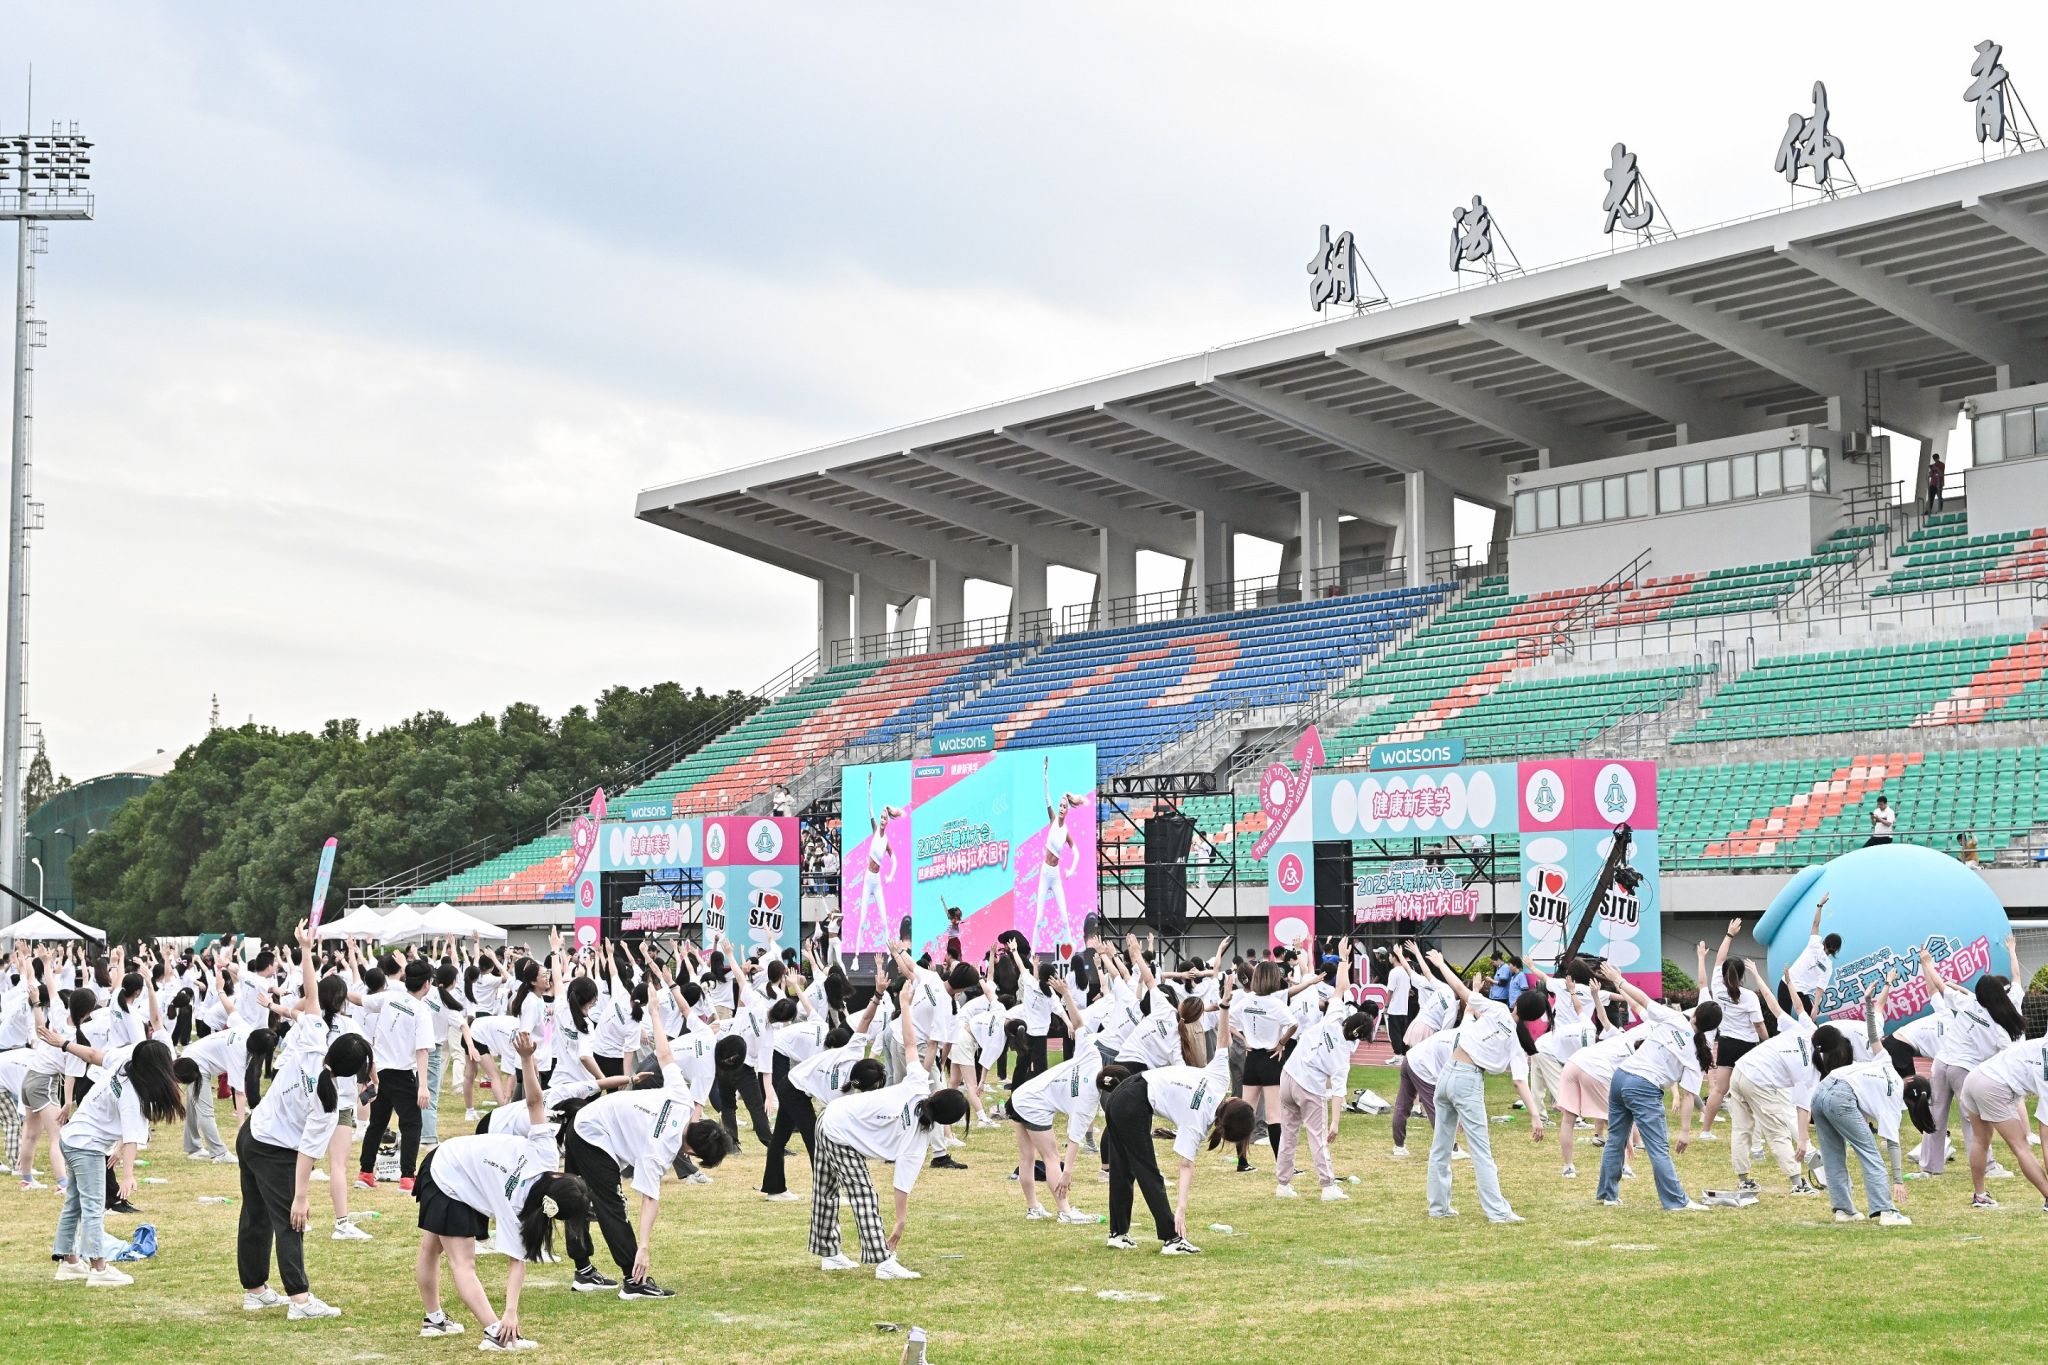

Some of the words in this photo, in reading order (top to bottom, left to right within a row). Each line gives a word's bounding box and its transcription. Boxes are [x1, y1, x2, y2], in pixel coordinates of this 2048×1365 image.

[938, 735, 987, 752] watsons
[1381, 746, 1451, 765] watsons
[631, 805, 667, 819] watsons
[1372, 786, 1451, 819] 健康新美学
[1537, 870, 1544, 892] I
[757, 892, 763, 908] I
[1529, 894, 1568, 923] SJTU
[1599, 892, 1638, 922] SJTU
[706, 910, 725, 931] SJTU
[749, 908, 782, 930] SJTU
